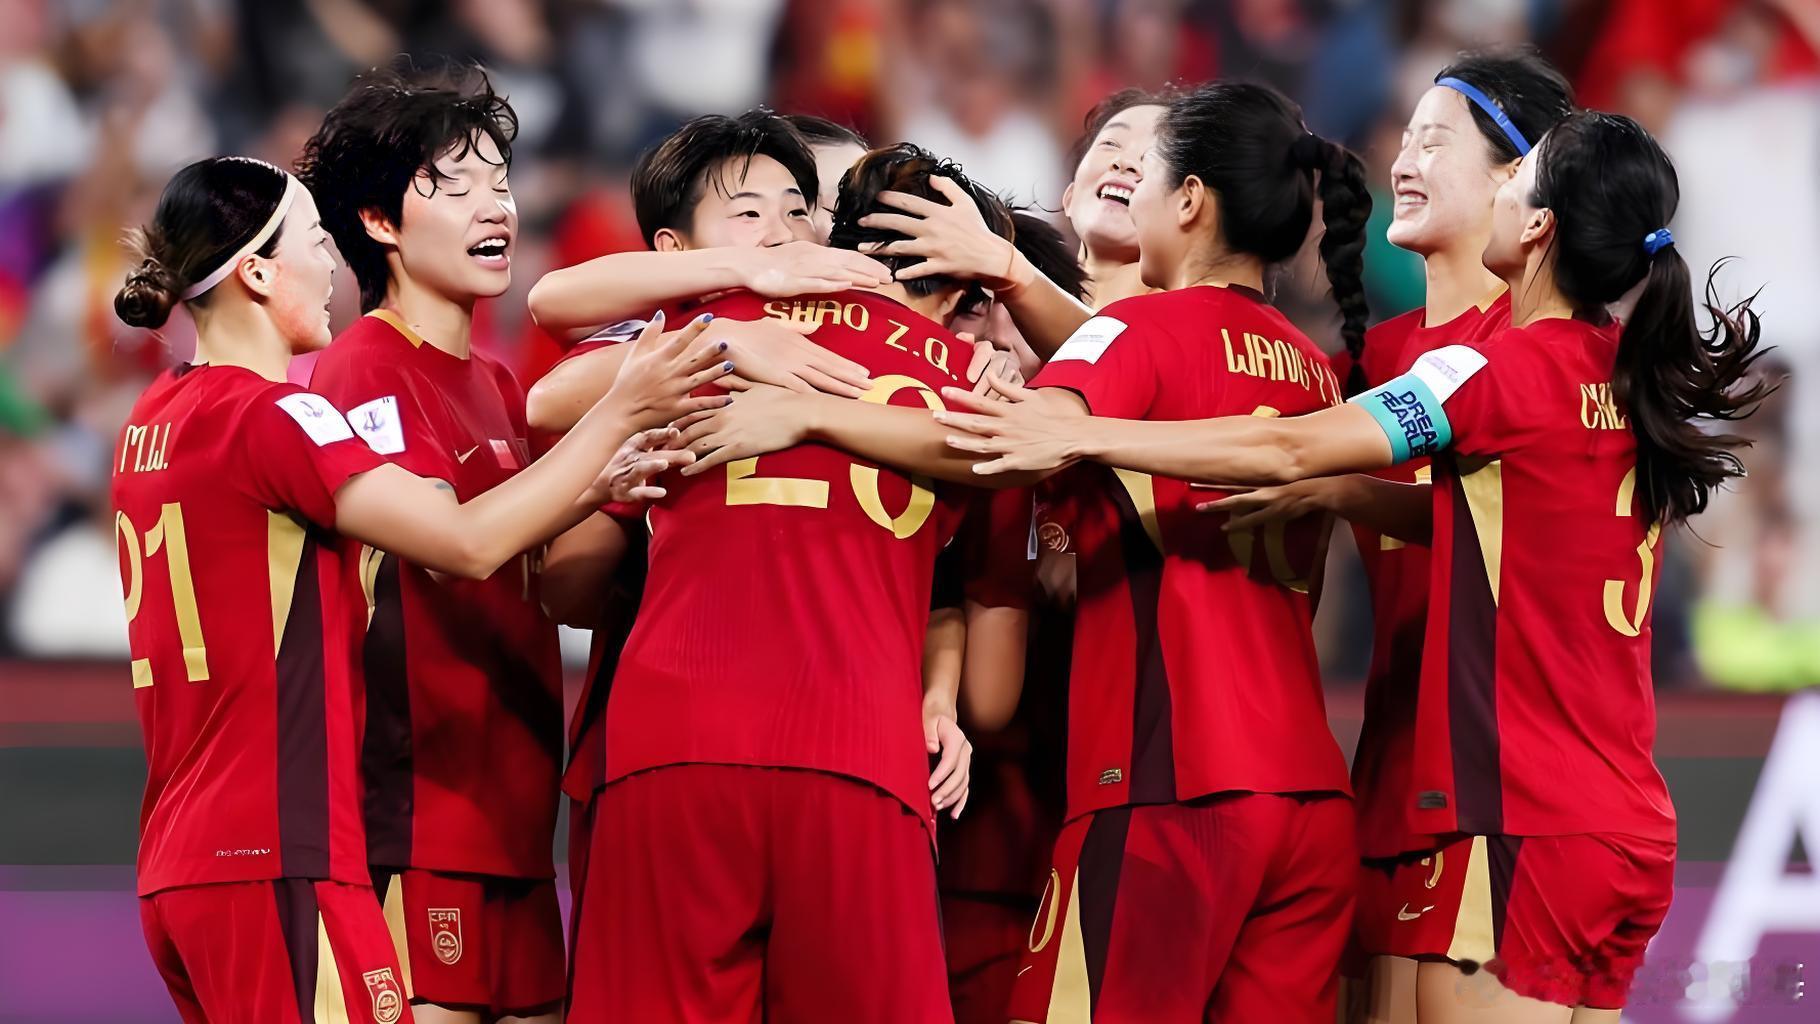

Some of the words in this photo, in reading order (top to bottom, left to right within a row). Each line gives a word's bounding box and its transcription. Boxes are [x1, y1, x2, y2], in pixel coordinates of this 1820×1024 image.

[763, 300, 869, 333] SHAO
[885, 319, 958, 381] Z.Q.
[1221, 328, 1310, 391] WANG
